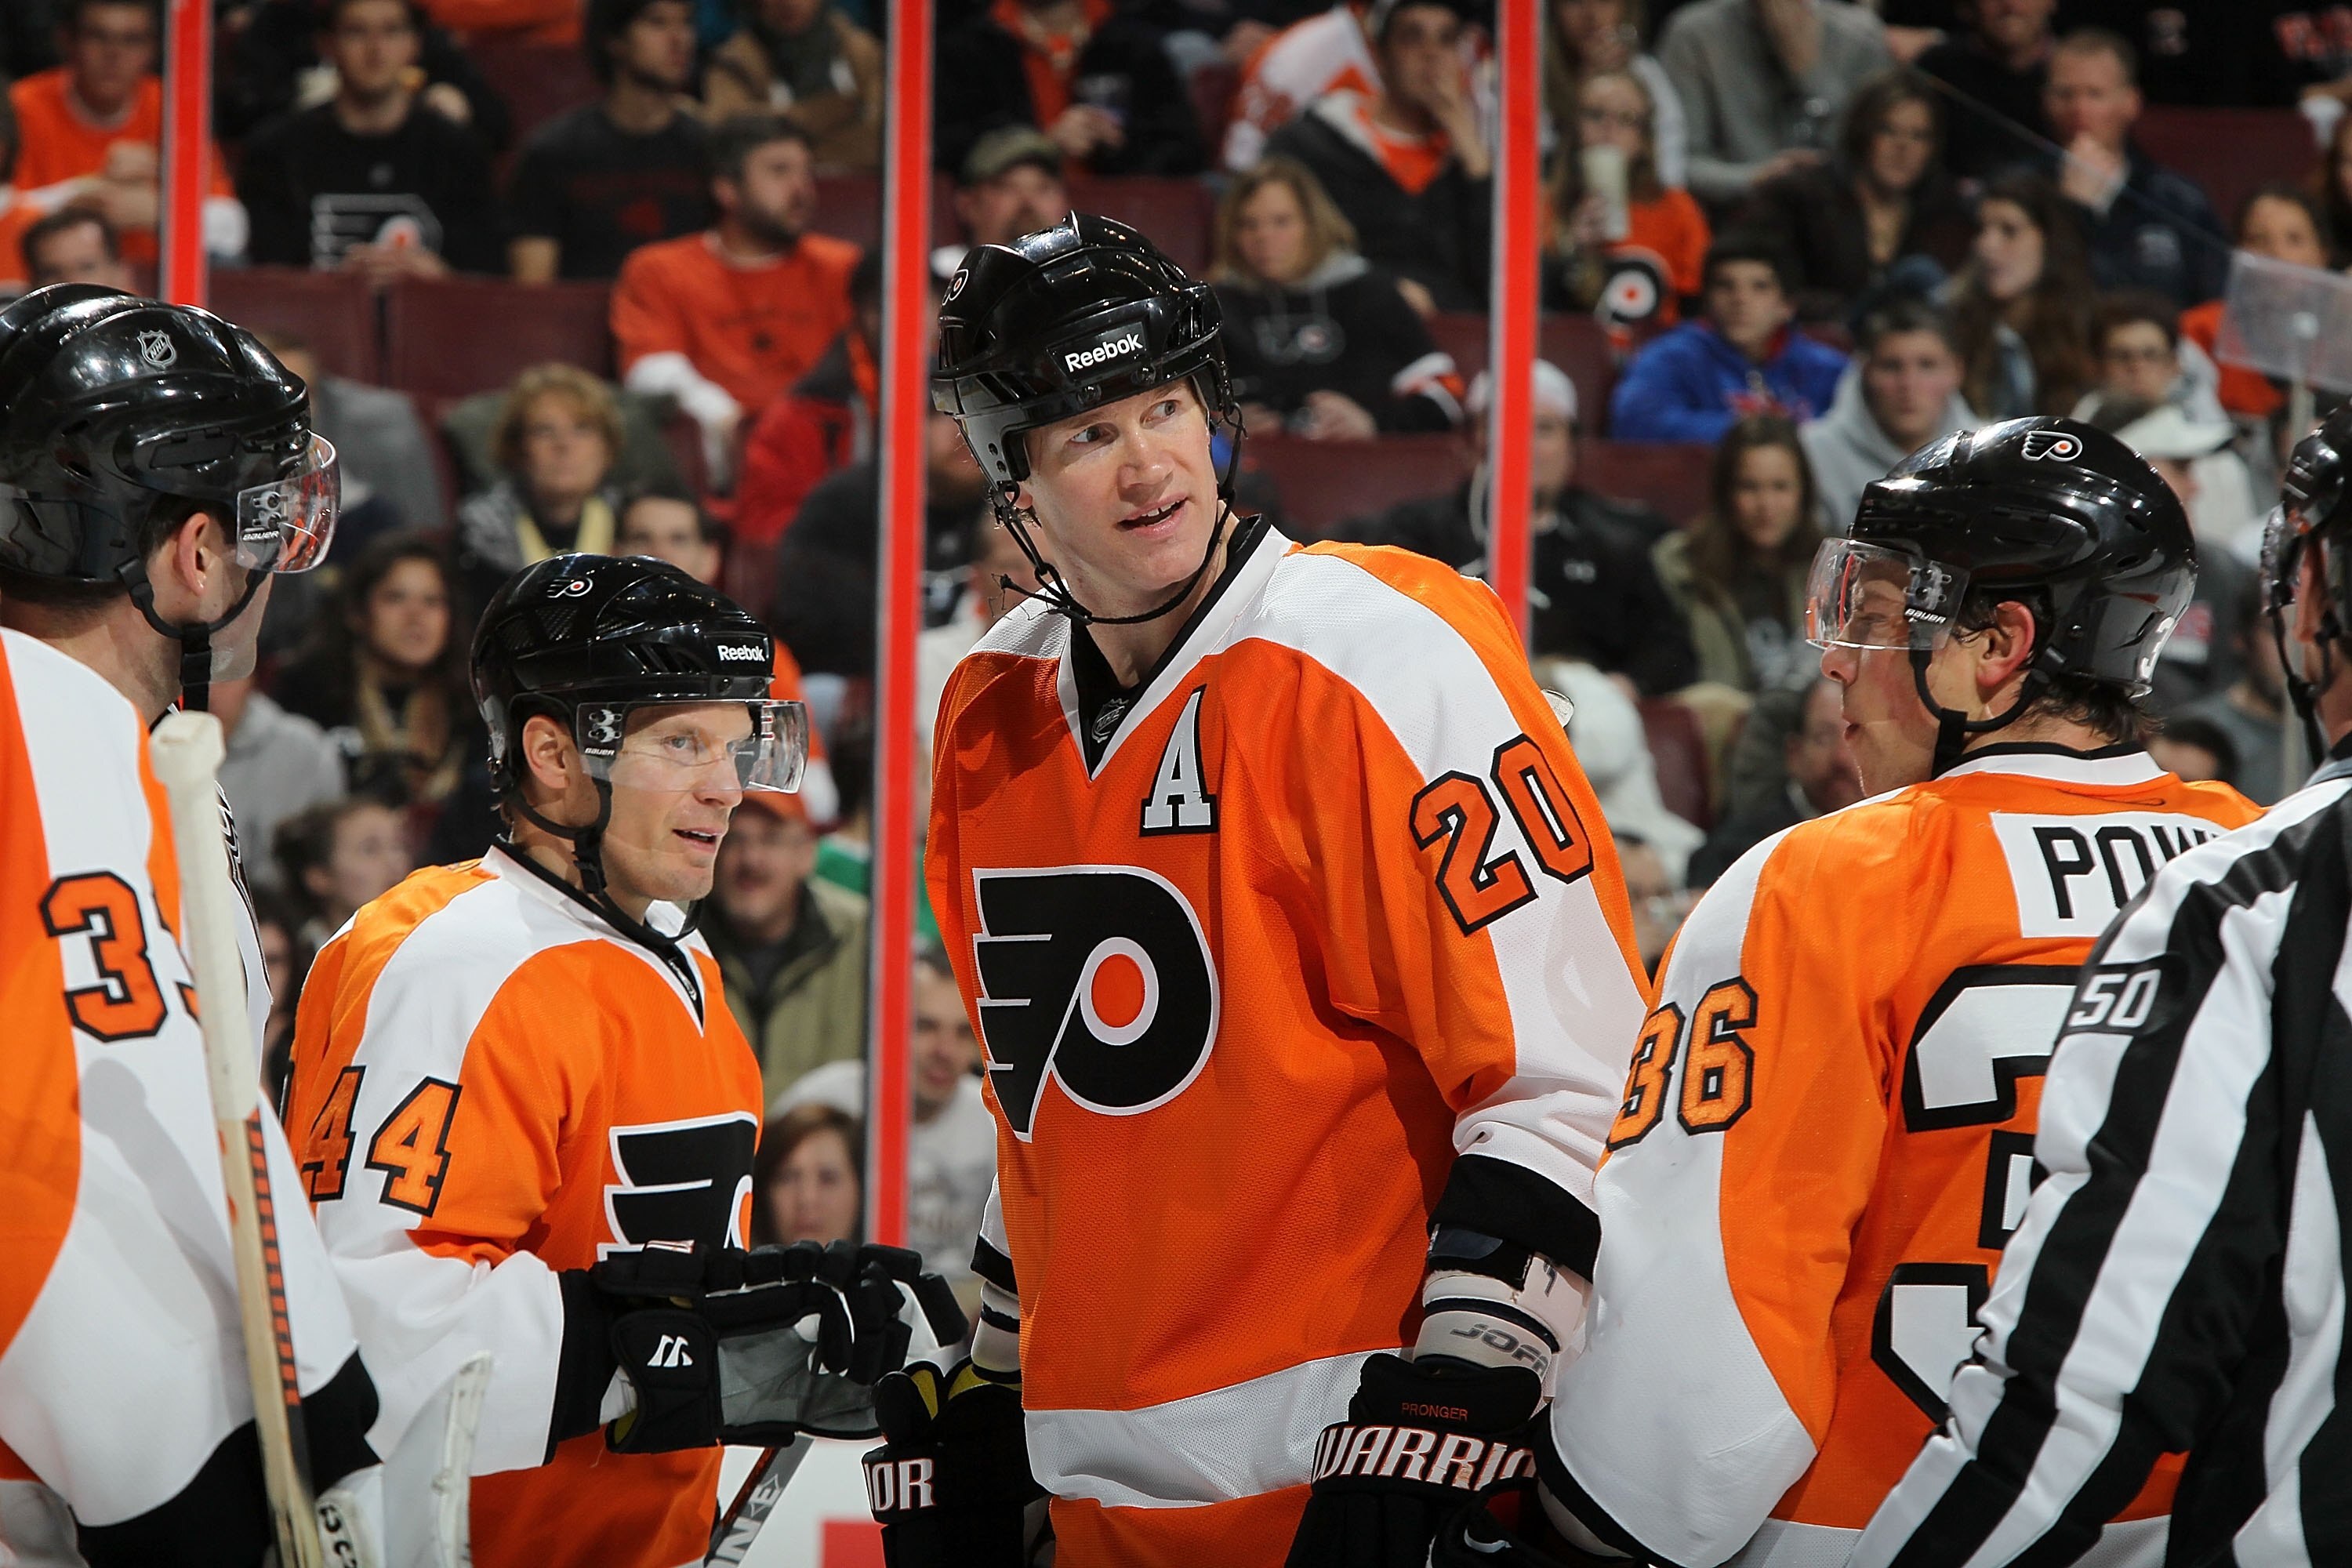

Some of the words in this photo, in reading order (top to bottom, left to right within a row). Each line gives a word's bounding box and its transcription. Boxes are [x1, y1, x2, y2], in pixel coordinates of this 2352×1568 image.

[1065, 333, 1143, 372] Reebok
[717, 644, 765, 662] Reebok
[1139, 684, 1219, 837] A
[1409, 733, 1595, 937] 20
[2032, 825, 2220, 919] POW
[39, 871, 201, 1044] 3
[2068, 968, 2161, 1028] 50
[1606, 975, 1759, 1152] 36
[299, 1065, 463, 1218] 44
[1402, 1402, 1468, 1422] PRONGER
[864, 1457, 938, 1512] OR
